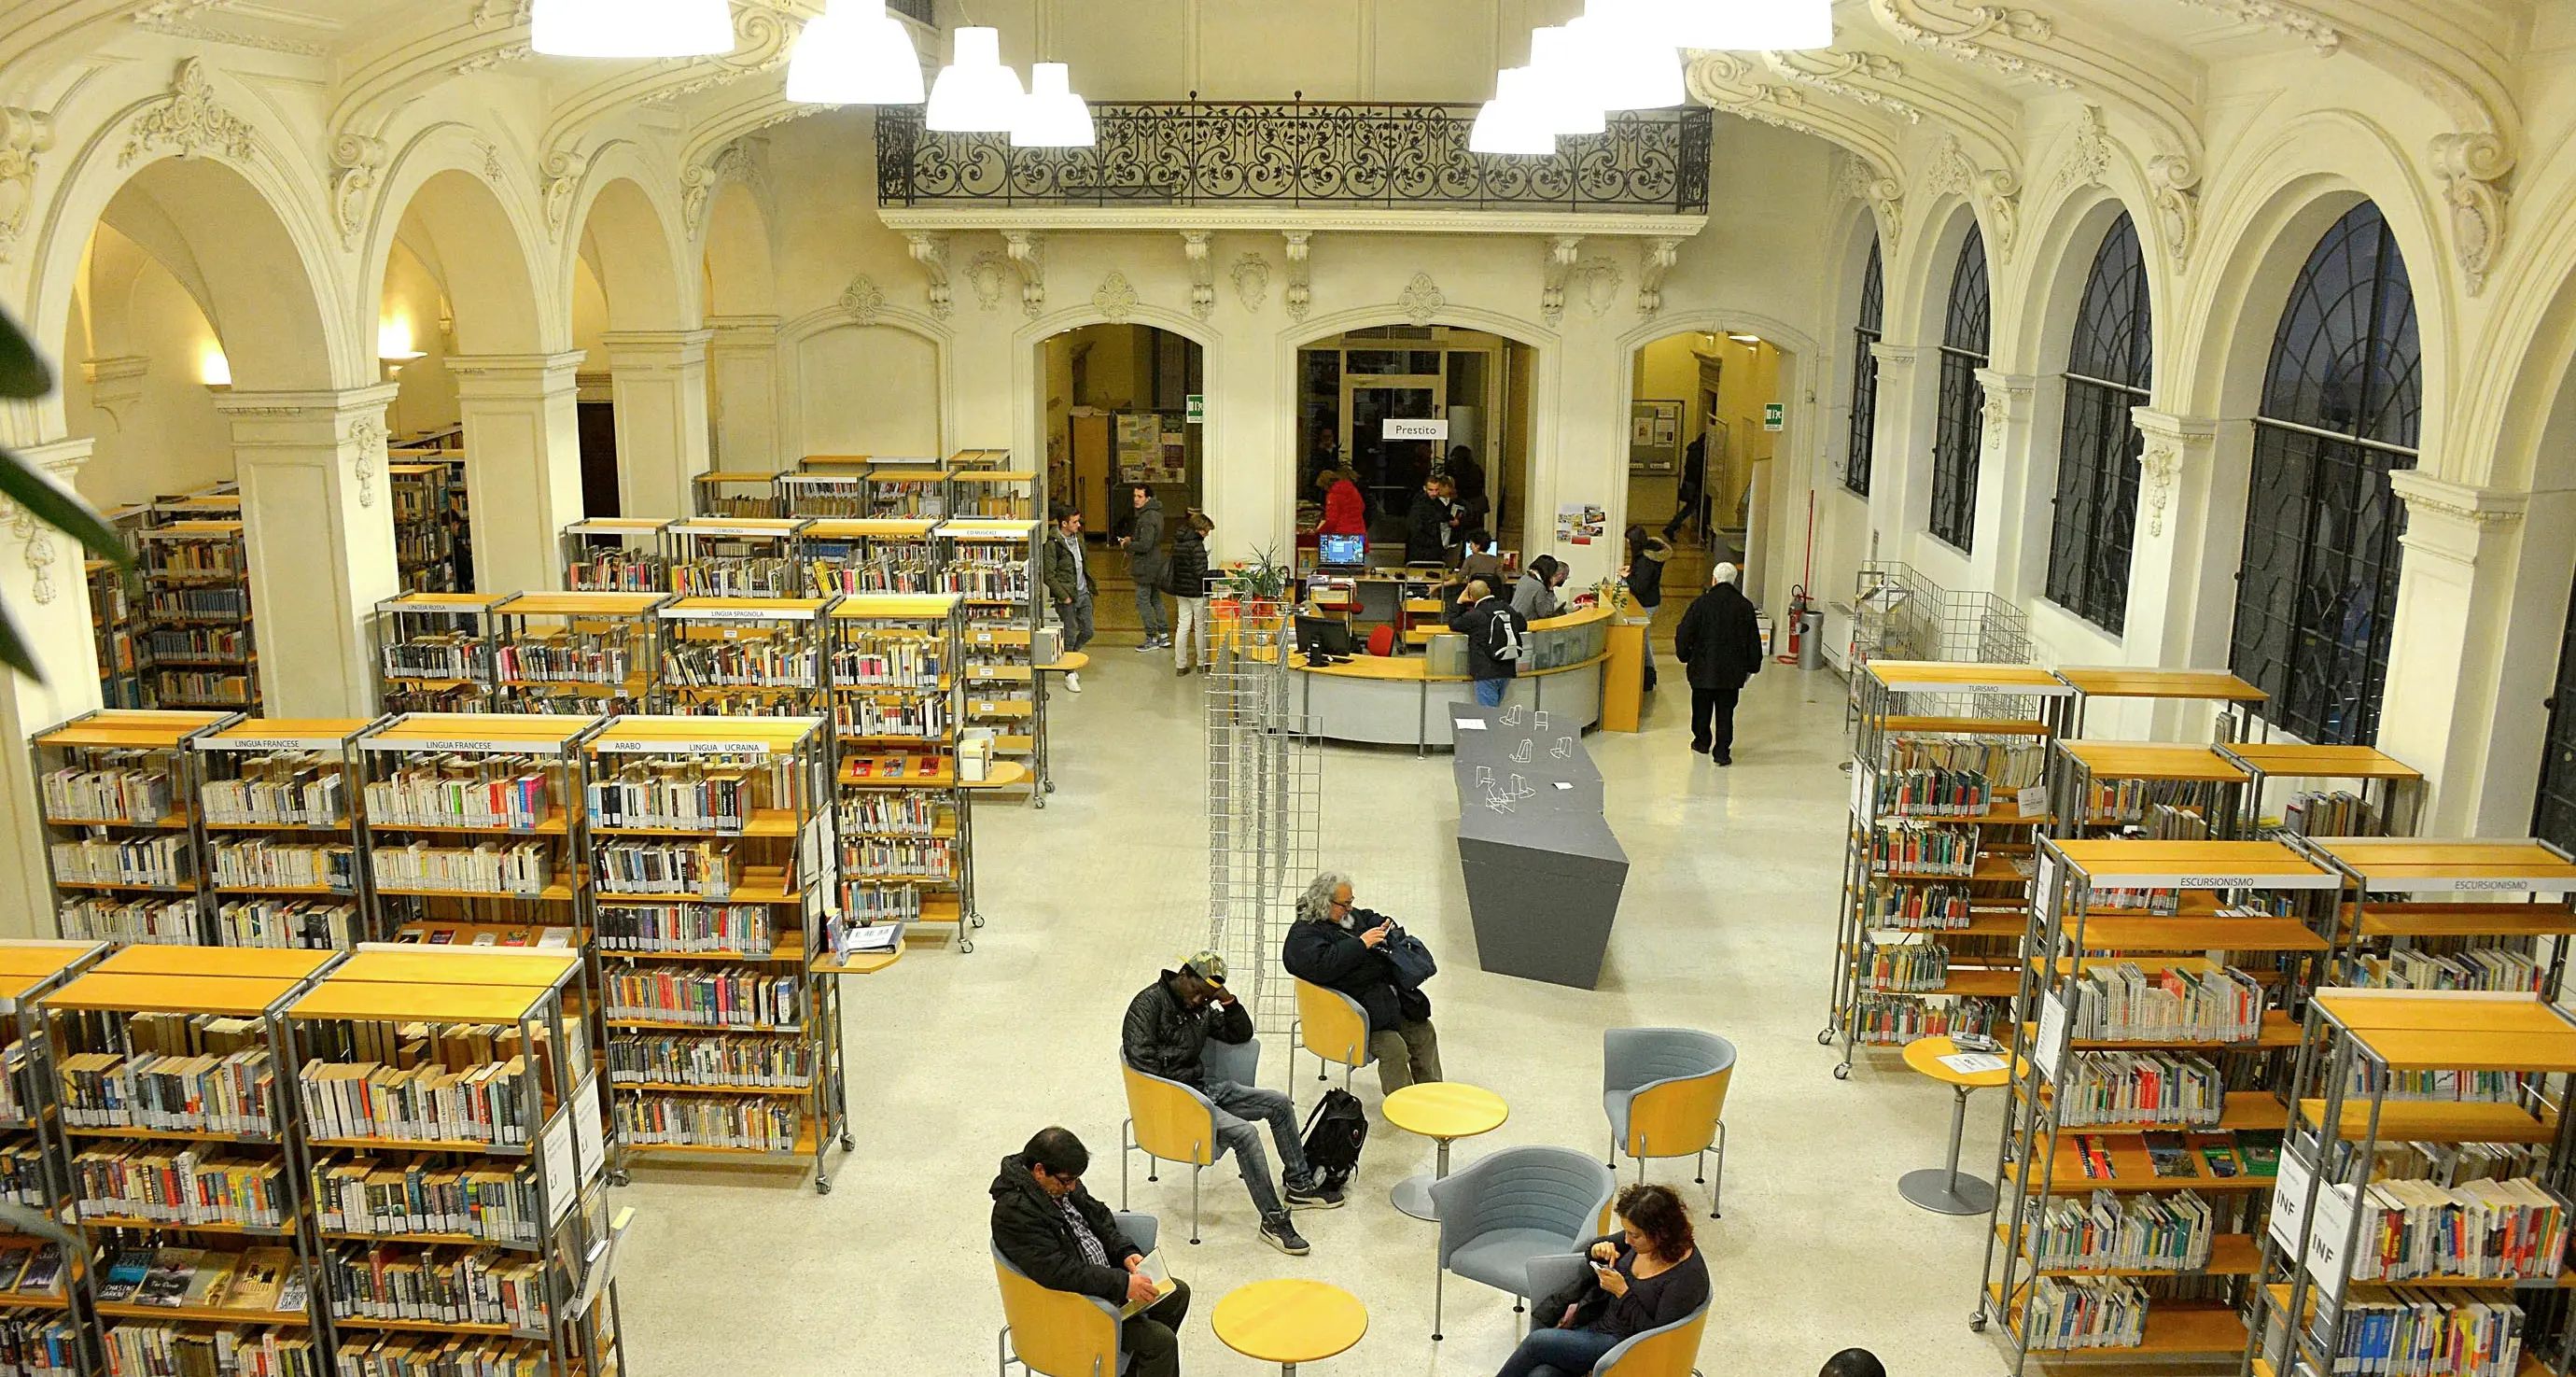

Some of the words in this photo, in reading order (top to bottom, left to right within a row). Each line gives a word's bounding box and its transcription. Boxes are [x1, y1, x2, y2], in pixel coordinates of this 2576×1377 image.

[1395, 425, 1437, 435] Prestito
[234, 739, 261, 748] LINGUA
[263, 739, 300, 748] FRANCESE
[455, 741, 492, 750] FRANCESE
[614, 742, 641, 751] ARABO
[2179, 878, 2254, 887] ESCURSIONISMO
[2455, 880, 2528, 890] ESCURSIONISMO
[2276, 1188, 2296, 1216] INF
[2312, 1233, 2334, 1264] INF
